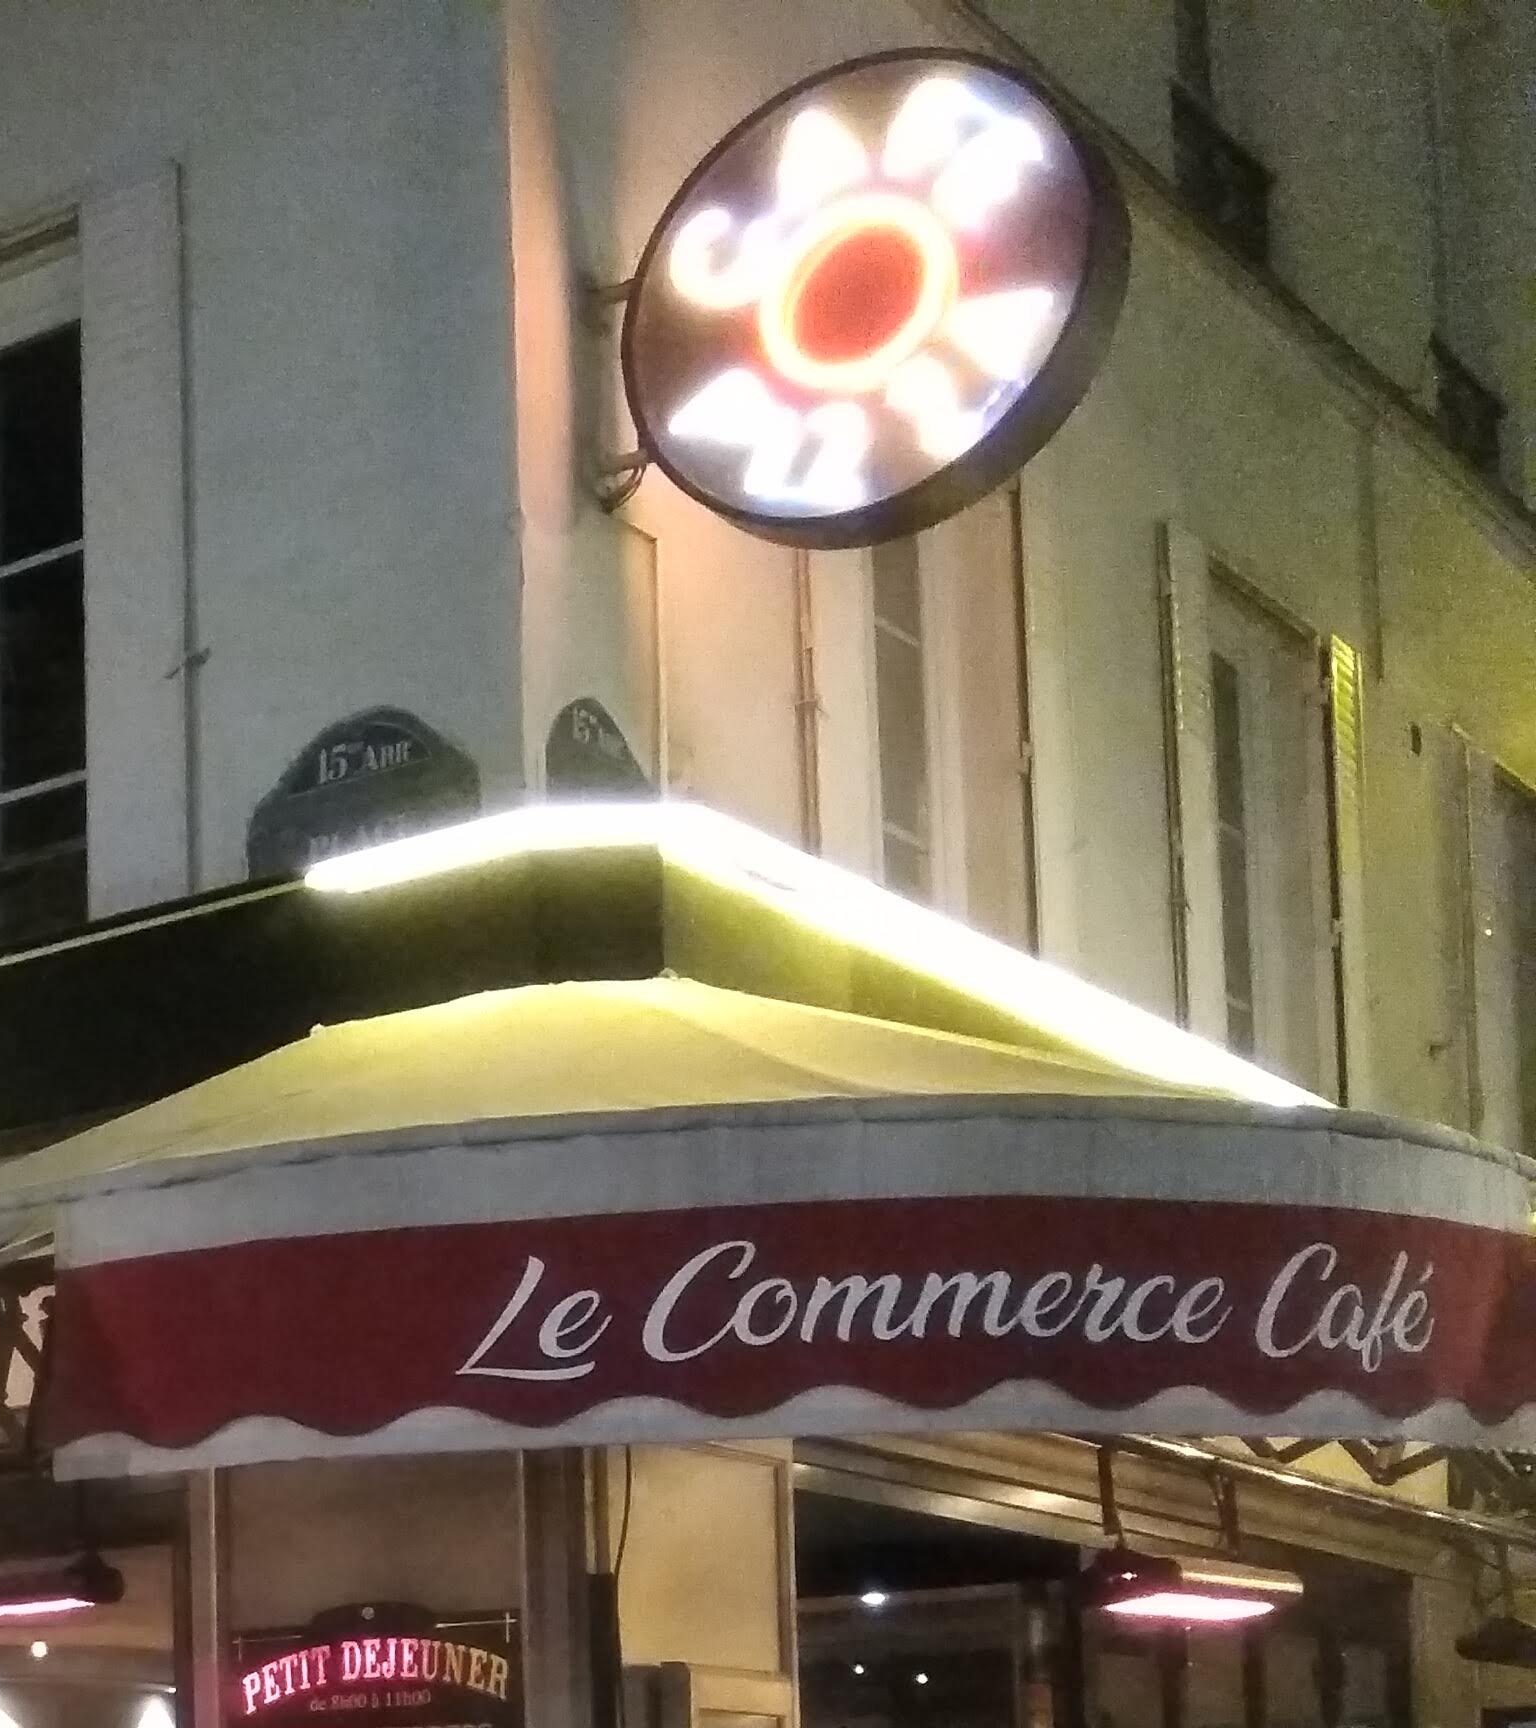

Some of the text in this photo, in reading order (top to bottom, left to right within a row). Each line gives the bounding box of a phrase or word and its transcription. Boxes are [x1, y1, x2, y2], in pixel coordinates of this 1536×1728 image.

[456, 1240, 1435, 1380] Le Commerce Café
[242, 1637, 509, 1715] PETIT DEJEUNER
[385, 1688, 431, 1707] 11h00
